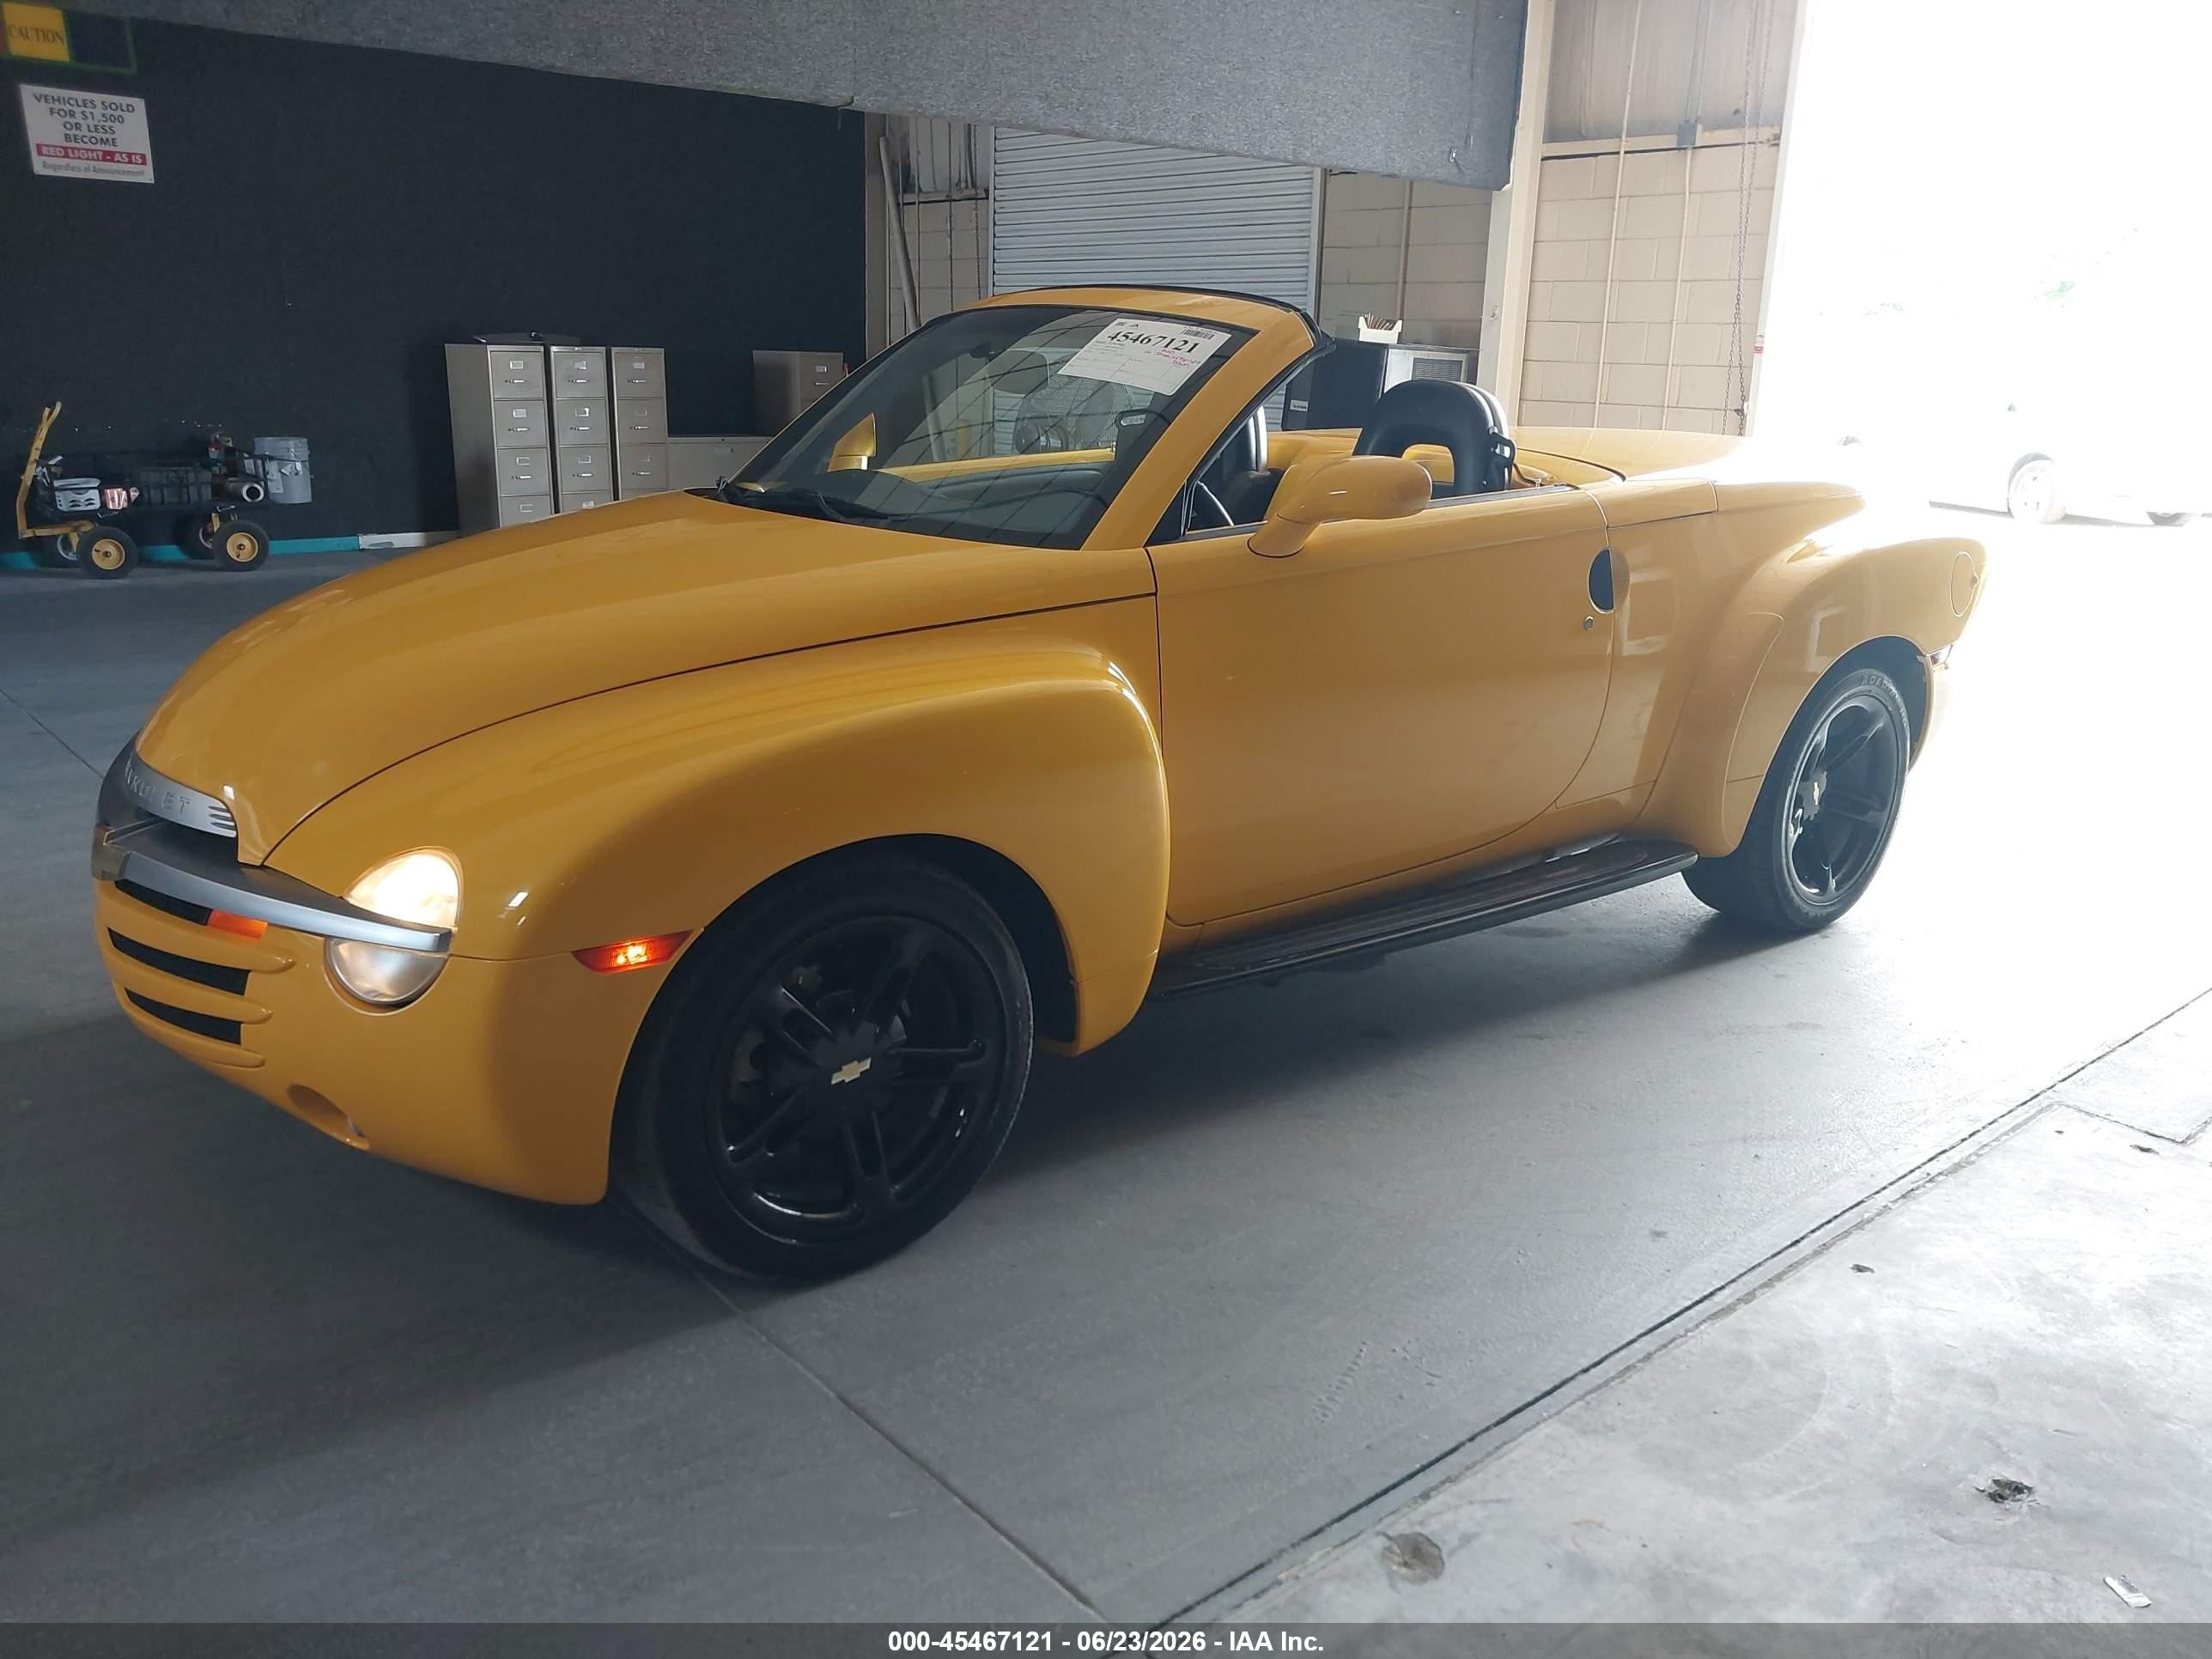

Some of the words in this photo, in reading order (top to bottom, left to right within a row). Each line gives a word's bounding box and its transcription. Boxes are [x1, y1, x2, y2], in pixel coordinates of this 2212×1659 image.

[9, 25, 64, 45] CAUTION
[33, 92, 97, 110] VEHICLES
[101, 100, 136, 113] SOLD
[49, 107, 76, 120] FOR
[82, 112, 125, 125] $1,500
[64, 121, 82, 132] OR
[87, 124, 116, 135] LESS
[64, 133, 118, 147] BECOME
[40, 145, 64, 157] RED
[68, 148, 104, 161] LIGHT
[113, 153, 129, 162] AS
[132, 154, 143, 164] IS
[1107, 330, 1200, 354] 45467121
